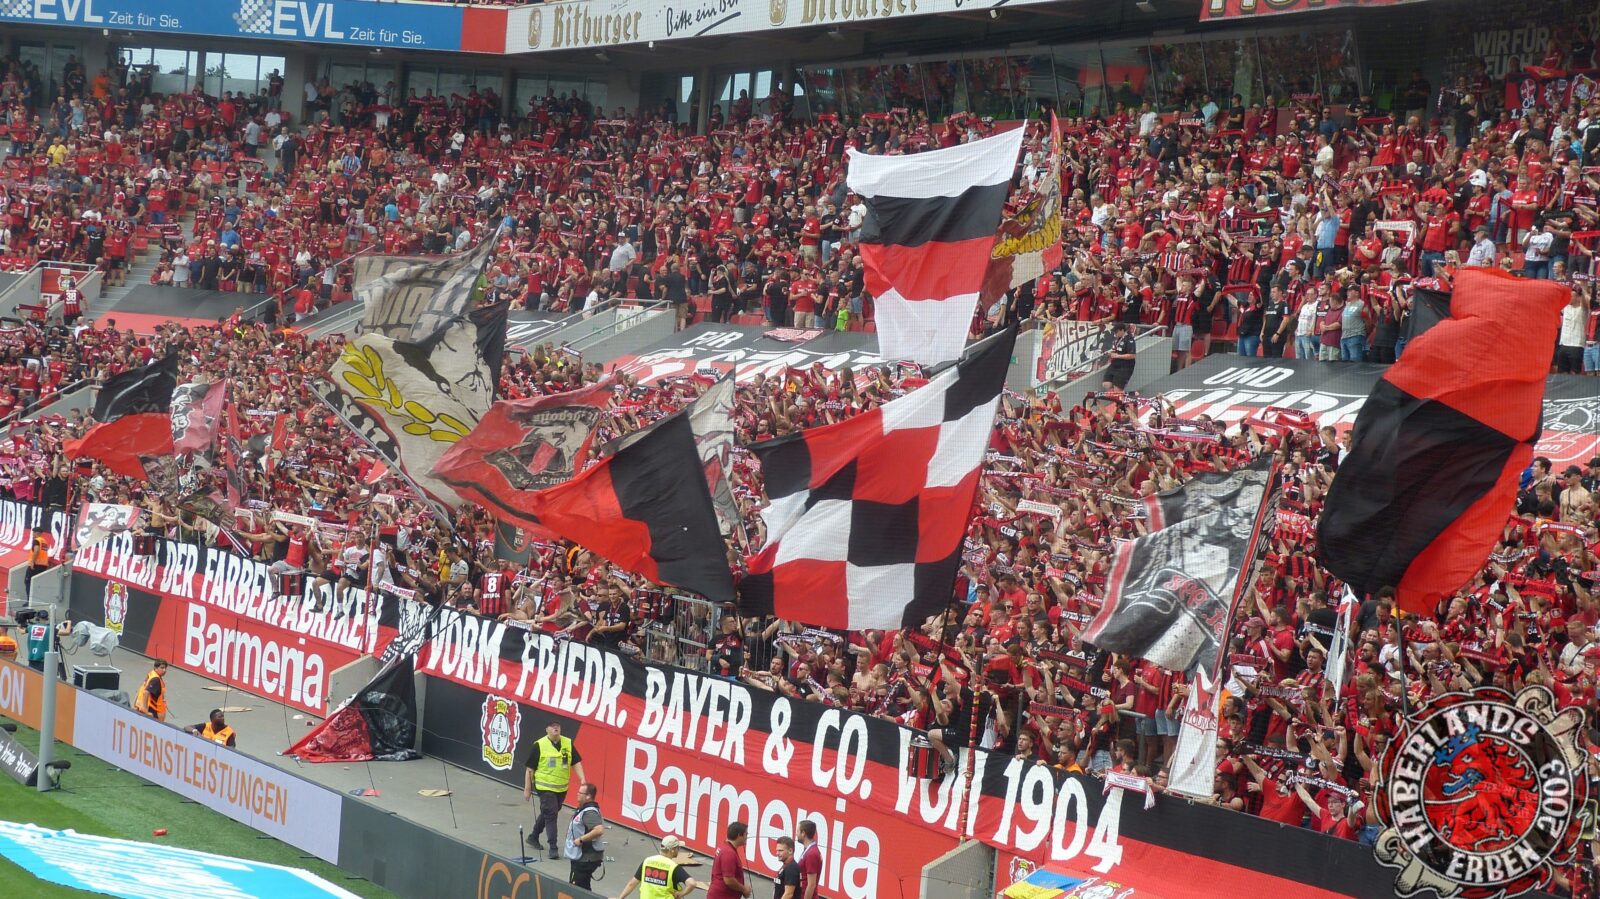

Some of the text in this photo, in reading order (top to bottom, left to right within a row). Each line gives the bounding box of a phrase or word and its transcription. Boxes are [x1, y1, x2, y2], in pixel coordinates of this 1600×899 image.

[34, 0, 183, 29] EVL Zeit für Sie.
[273, 1, 426, 45] EVL Zeit für Sie.
[551, 4, 642, 48] Bitburger
[666, 7, 693, 37] Bitte
[695, 1, 718, 22] ein
[1203, 365, 1295, 388] UND
[487, 577, 497, 592] 8
[184, 602, 325, 710] Barmenia
[160, 540, 199, 599] DER
[426, 608, 507, 690] VORM.
[515, 631, 627, 728] FRIEDR.
[637, 666, 752, 767] BAYER
[762, 696, 795, 779] &
[811, 708, 873, 800] CO.
[992, 757, 1124, 875] 1904
[111, 717, 289, 827] IT DIENSTLEISTUNGEN
[621, 738, 881, 899] Barmenia
